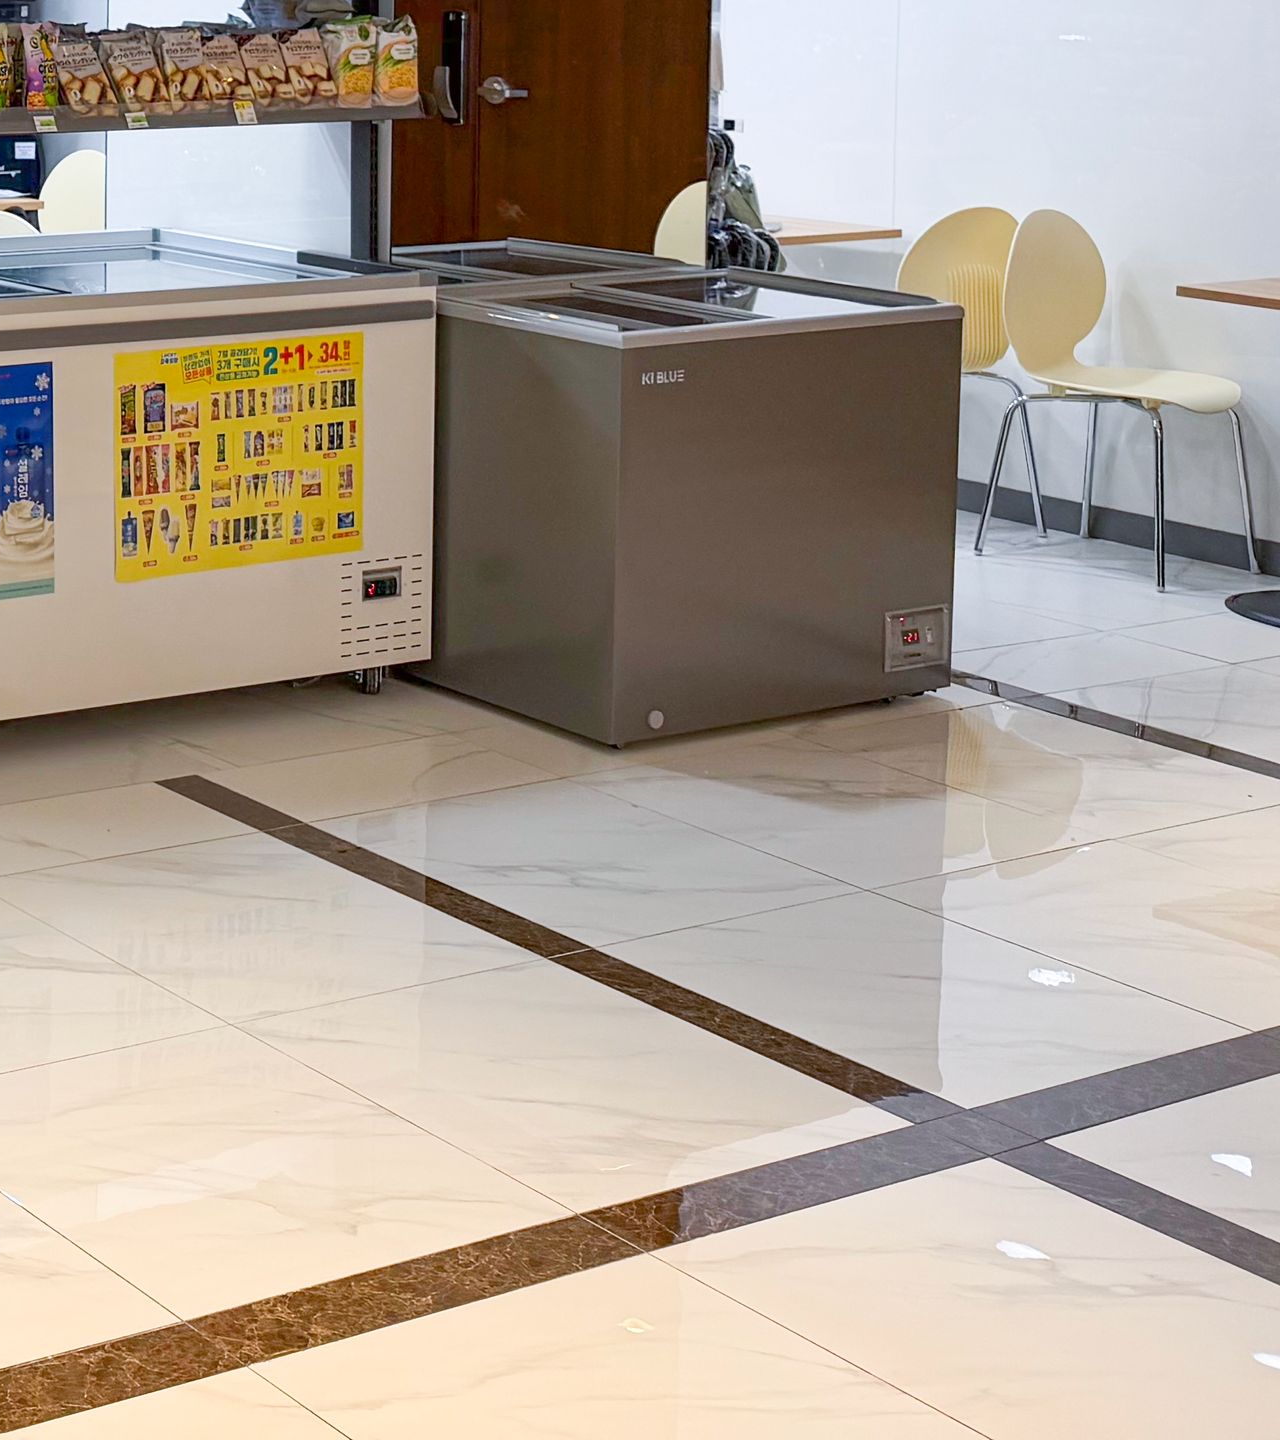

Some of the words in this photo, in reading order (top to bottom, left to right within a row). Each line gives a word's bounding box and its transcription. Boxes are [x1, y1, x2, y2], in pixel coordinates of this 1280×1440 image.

[263, 344, 305, 375] 2+1
[642, 371, 655, 385] KI
[656, 369, 685, 384] BLUE
